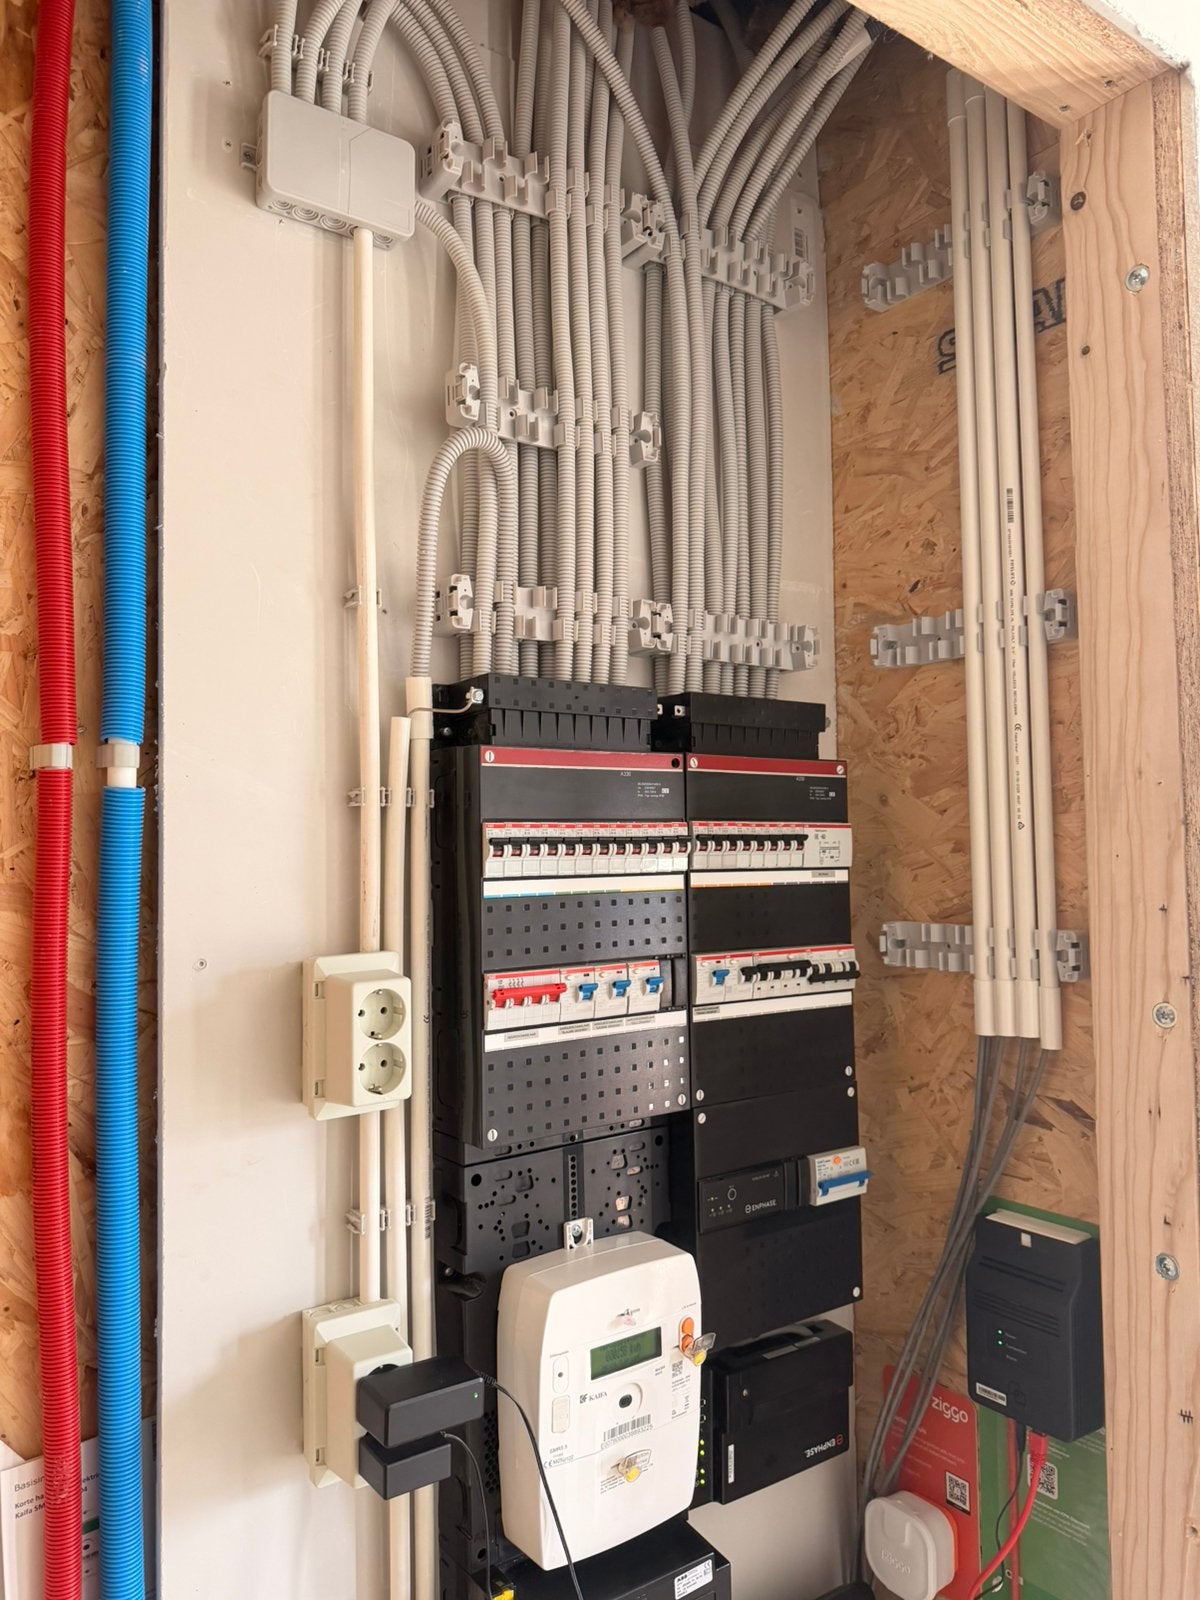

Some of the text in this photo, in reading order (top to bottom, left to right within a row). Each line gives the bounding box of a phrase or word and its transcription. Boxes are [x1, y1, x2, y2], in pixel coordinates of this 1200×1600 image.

[751, 1199, 777, 1212] ENPHASE
[589, 1391, 608, 1402] KAIFA
[931, 1396, 969, 1424] ziggo
[804, 1438, 836, 1458] ENPHASE
[14, 1475, 45, 1492] Basisin
[15, 1497, 34, 1509] Korte
[15, 1508, 33, 1519] Kaifa
[677, 1574, 688, 1583] ABB
